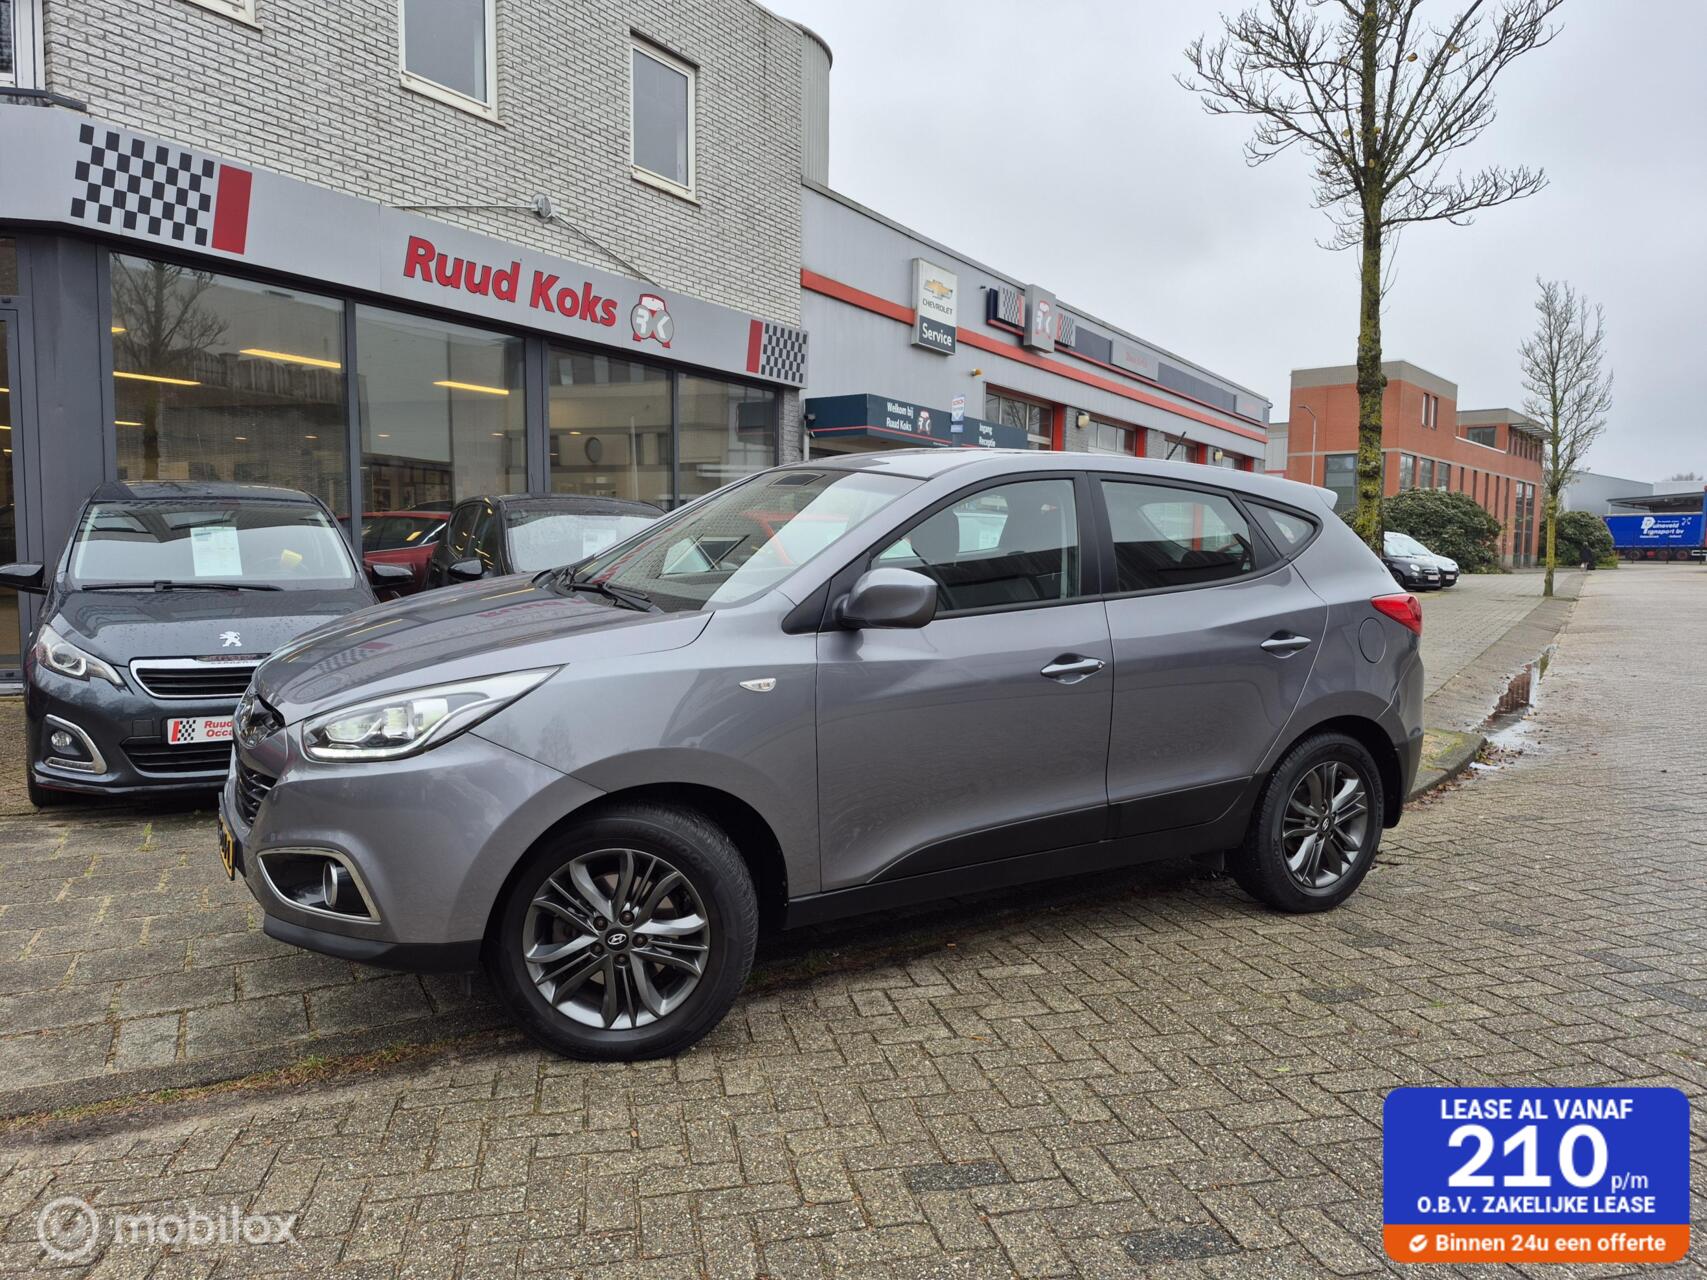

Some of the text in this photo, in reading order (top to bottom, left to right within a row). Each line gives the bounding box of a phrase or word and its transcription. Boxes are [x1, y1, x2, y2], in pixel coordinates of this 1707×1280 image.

[403, 235, 618, 328] Ruud Koks
[922, 298, 953, 315] CHEVROLET
[921, 322, 953, 347] Service
[886, 401, 907, 416] Welkom
[886, 417, 912, 432] Ruud Koks
